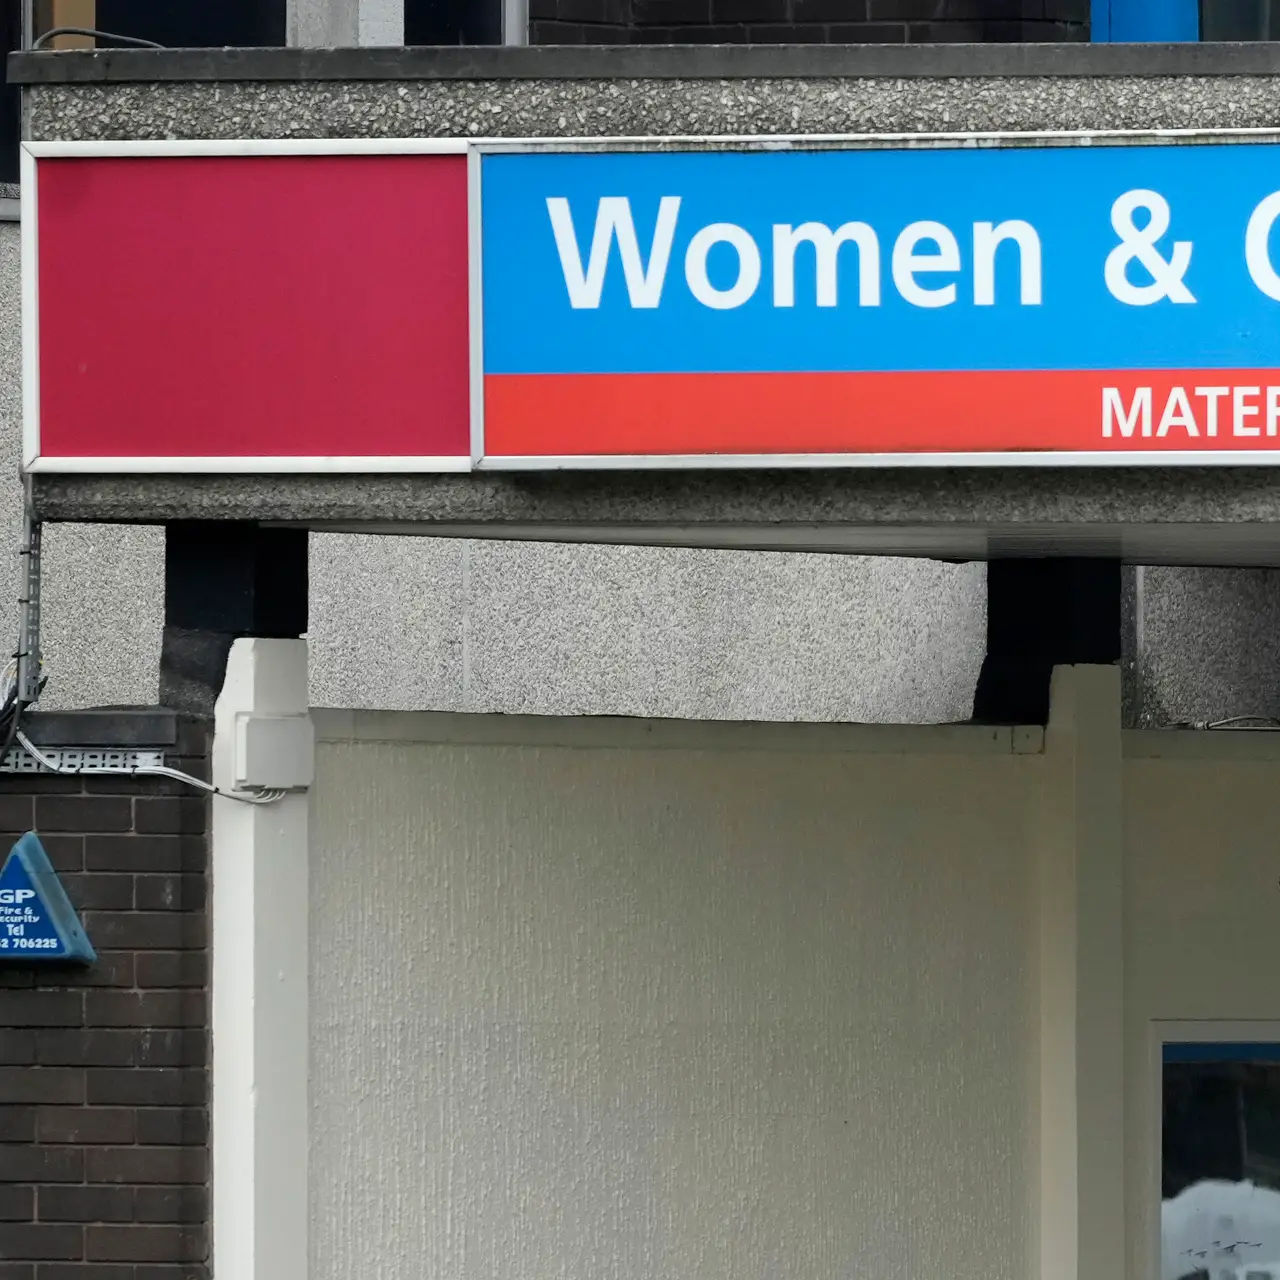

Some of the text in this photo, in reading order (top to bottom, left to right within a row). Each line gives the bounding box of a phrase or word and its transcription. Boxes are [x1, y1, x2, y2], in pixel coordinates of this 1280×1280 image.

[548, 197, 1041, 308] Women
[1105, 190, 1196, 305] &
[24, 906, 33, 915] &
[6, 924, 24, 936] Tel
[0, 938, 58, 948] 2 706225
